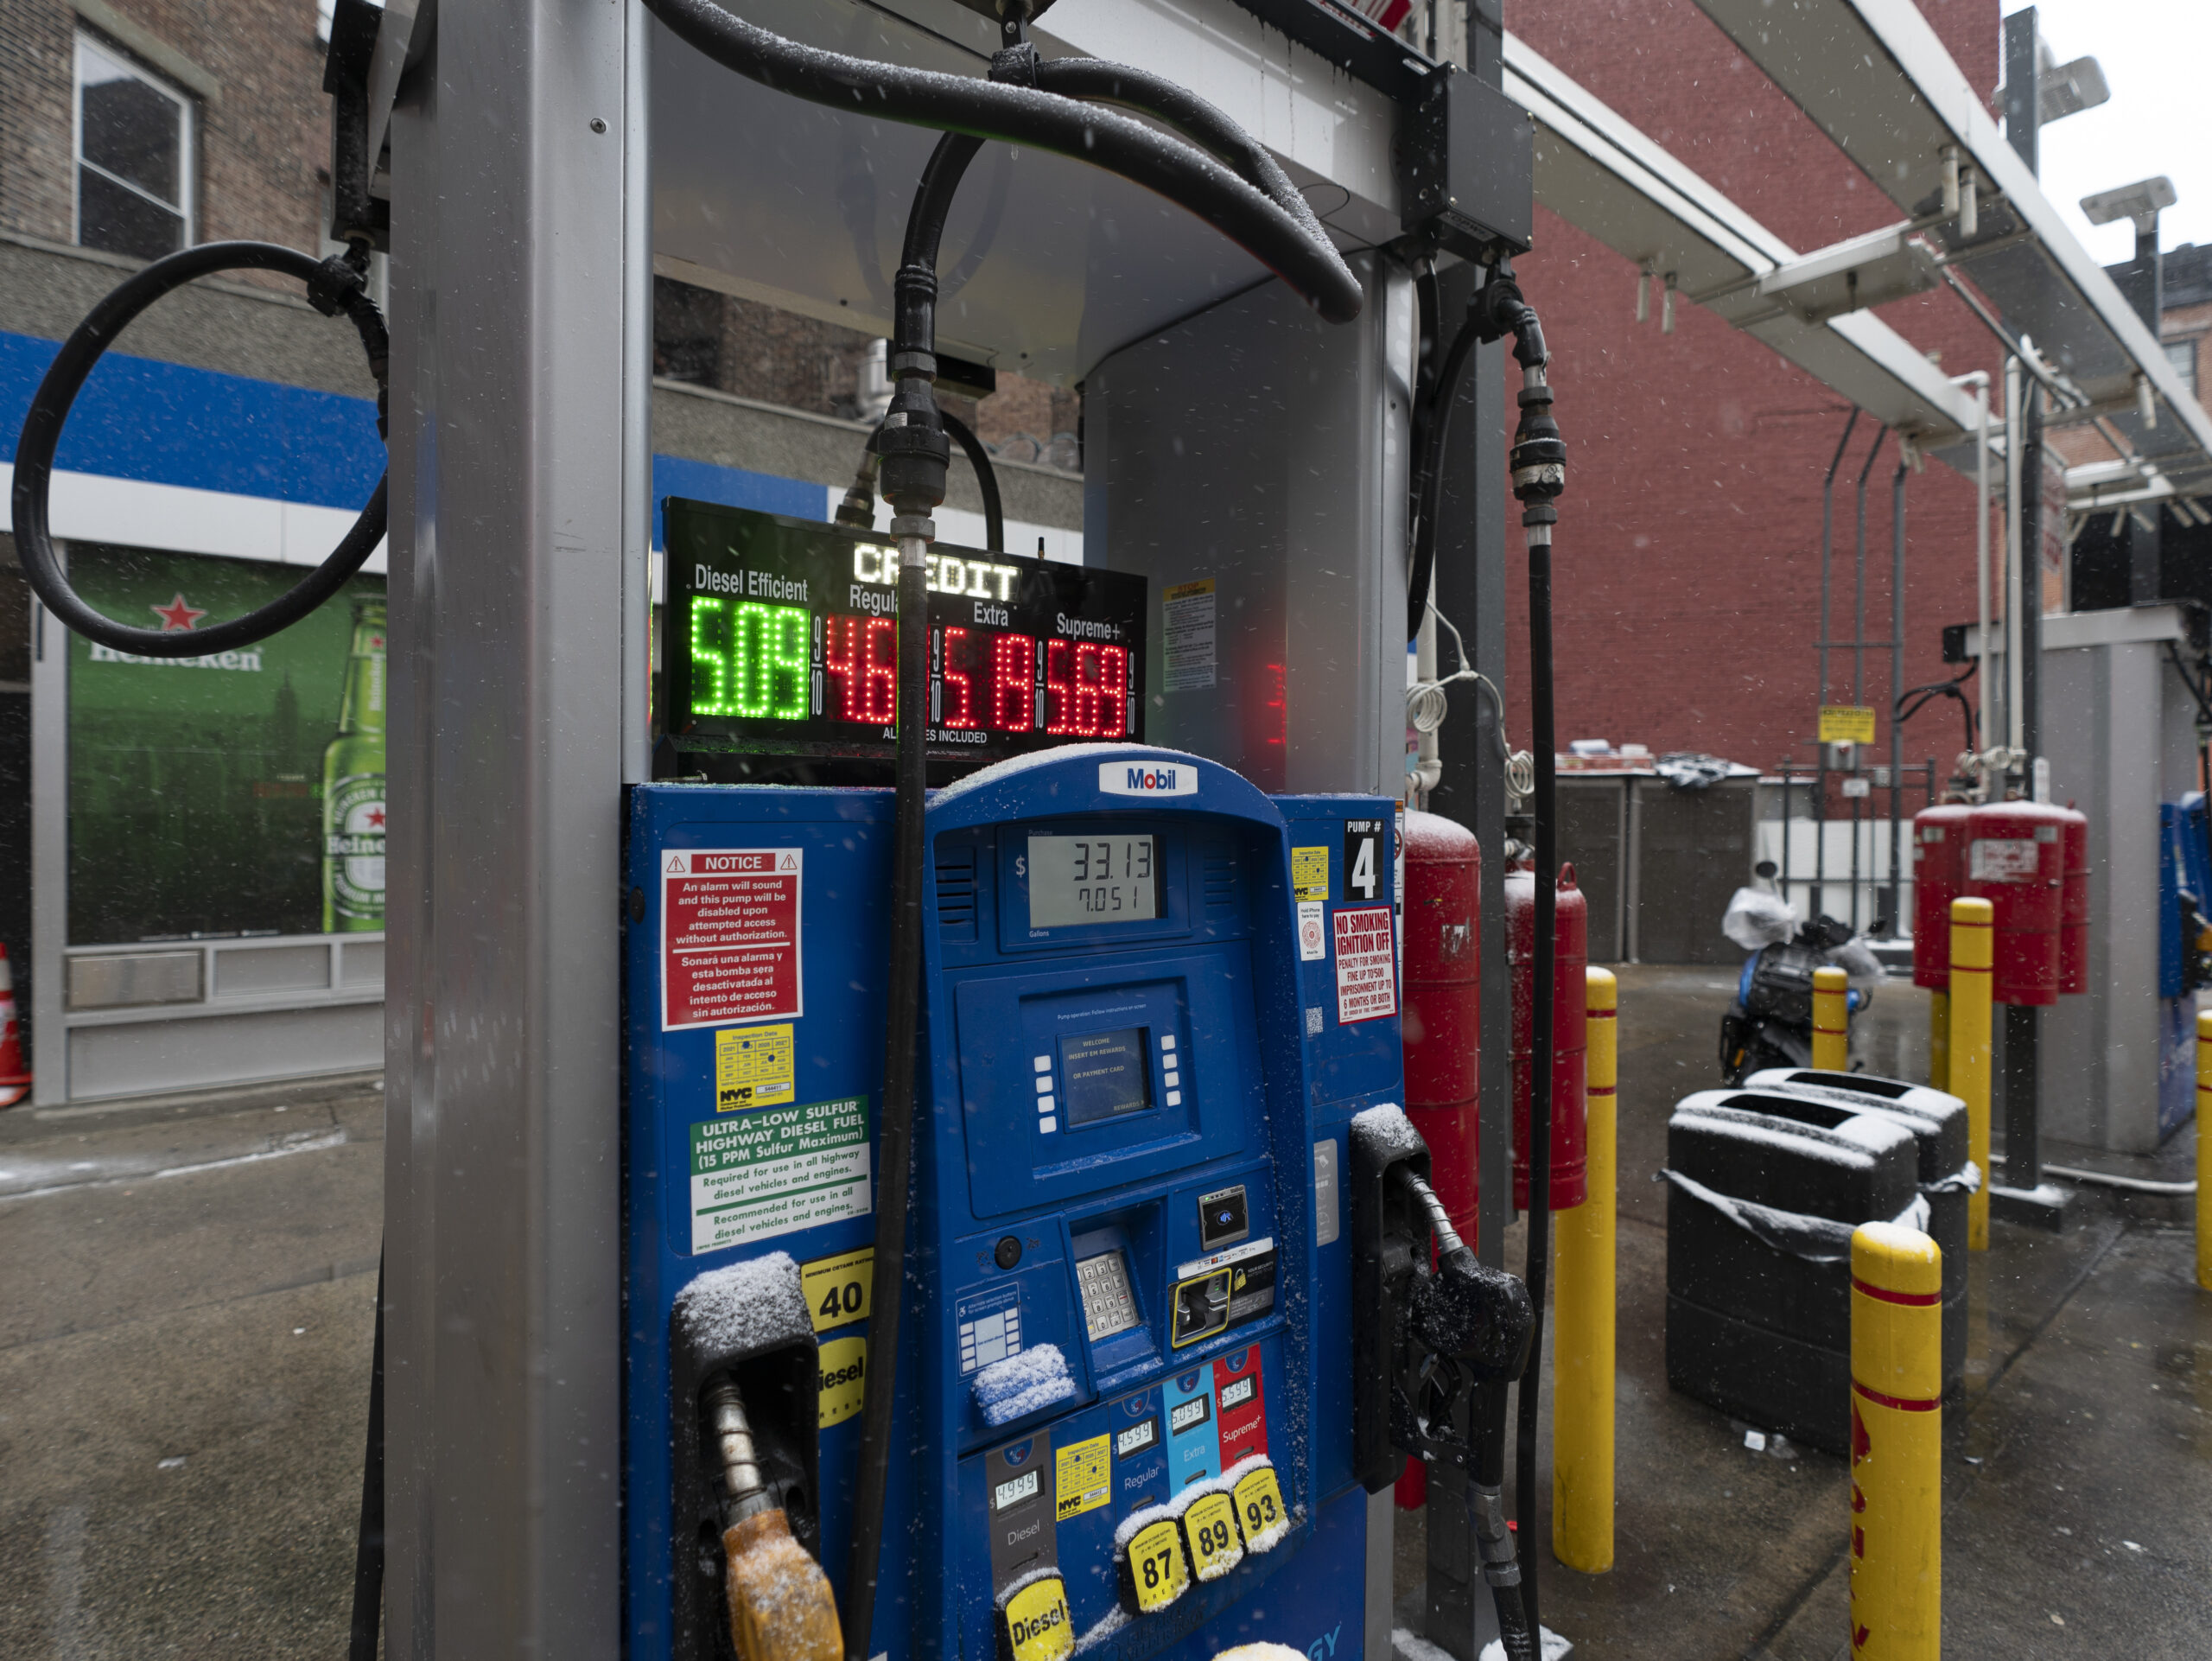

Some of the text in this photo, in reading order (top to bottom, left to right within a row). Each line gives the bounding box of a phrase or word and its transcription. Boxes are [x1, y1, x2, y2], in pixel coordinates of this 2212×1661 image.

[695, 563, 808, 601] Diesel Efficient
[850, 584, 899, 617] Regul
[974, 601, 1009, 627] Extra
[1057, 612, 1121, 640] Supreme+
[826, 617, 897, 722] 4.6
[882, 727, 897, 740] AL
[938, 729, 987, 743] INCLUDED
[1127, 767, 1176, 790] Mobil
[1347, 820, 1382, 833] PUMP #
[327, 836, 385, 854] Heine
[705, 856, 762, 870] NOTICE
[1015, 842, 1151, 881] $ 33.13
[1351, 837, 1376, 900] 4
[683, 880, 782, 892] An alarm will sound
[678, 892, 786, 906] and this pump will be
[1079, 886, 1137, 912] 7.051
[697, 907, 768, 918] disabled upon
[1336, 912, 1389, 935] NO SMOKING
[689, 919, 776, 932] attempted access
[676, 930, 787, 945] without authorization.
[1337, 932, 1389, 956] IGNITION OFF
[681, 951, 783, 967] Sonará una alarma y
[1338, 953, 1390, 971] PENALTY FOR SMOKING
[692, 969, 714, 979] esta
[715, 966, 751, 977] bomba
[1347, 971, 1358, 982] FINE
[1359, 970, 1366, 980] UP
[1367, 969, 1373, 979] TO
[692, 977, 773, 992] desactivatada al
[1340, 979, 1391, 996] IMPRISONMENT UP TO
[690, 990, 777, 1005] intento de acceso
[1344, 992, 1390, 1009] 6 MONTHS OR BOTH
[693, 1009, 709, 1018] sin
[1068, 1051, 1090, 1060] INSERT
[1099, 1046, 1126, 1055] REWARDS
[1083, 1037, 1110, 1047] WELCOME
[1082, 1067, 1108, 1079] PAYMENT
[720, 1087, 753, 1103] NYC
[1113, 1101, 1140, 1111] REWARDS
[702, 1101, 857, 1137] ULTRA-LOW SULFUR
[696, 1114, 865, 1155] HIGHWAY DIESEL FUEL
[698, 1127, 863, 1170] (15 PPM Sulfur Maximum)
[703, 1149, 860, 1187] Required for use in all highway
[714, 1167, 852, 1200] diesel vehicles and engines.
[714, 1186, 854, 1225] Recommended for use in all
[715, 1224, 746, 1240] diesel
[749, 1216, 789, 1232] vehicles
[792, 1211, 810, 1222] and
[814, 1202, 853, 1218] engines.
[804, 1268, 831, 1278] MINIMUM
[832, 1262, 854, 1272] CETANE
[819, 1281, 863, 1319] 40
[819, 1356, 863, 1391] iesel
[819, 1398, 861, 1419] RESS
[1223, 1415, 1262, 1443] Supreme+
[1184, 1445, 1206, 1462] Extra
[997, 1472, 1034, 1501] 4.999
[1124, 1466, 1160, 1491] Regular
[1058, 1495, 1082, 1512] NYC
[1246, 1494, 1276, 1531] 93
[1007, 1519, 1040, 1545] Diesel
[1198, 1519, 1229, 1556] 89
[1142, 1548, 1172, 1589] 87
[1012, 1599, 1065, 1647] Diesel
